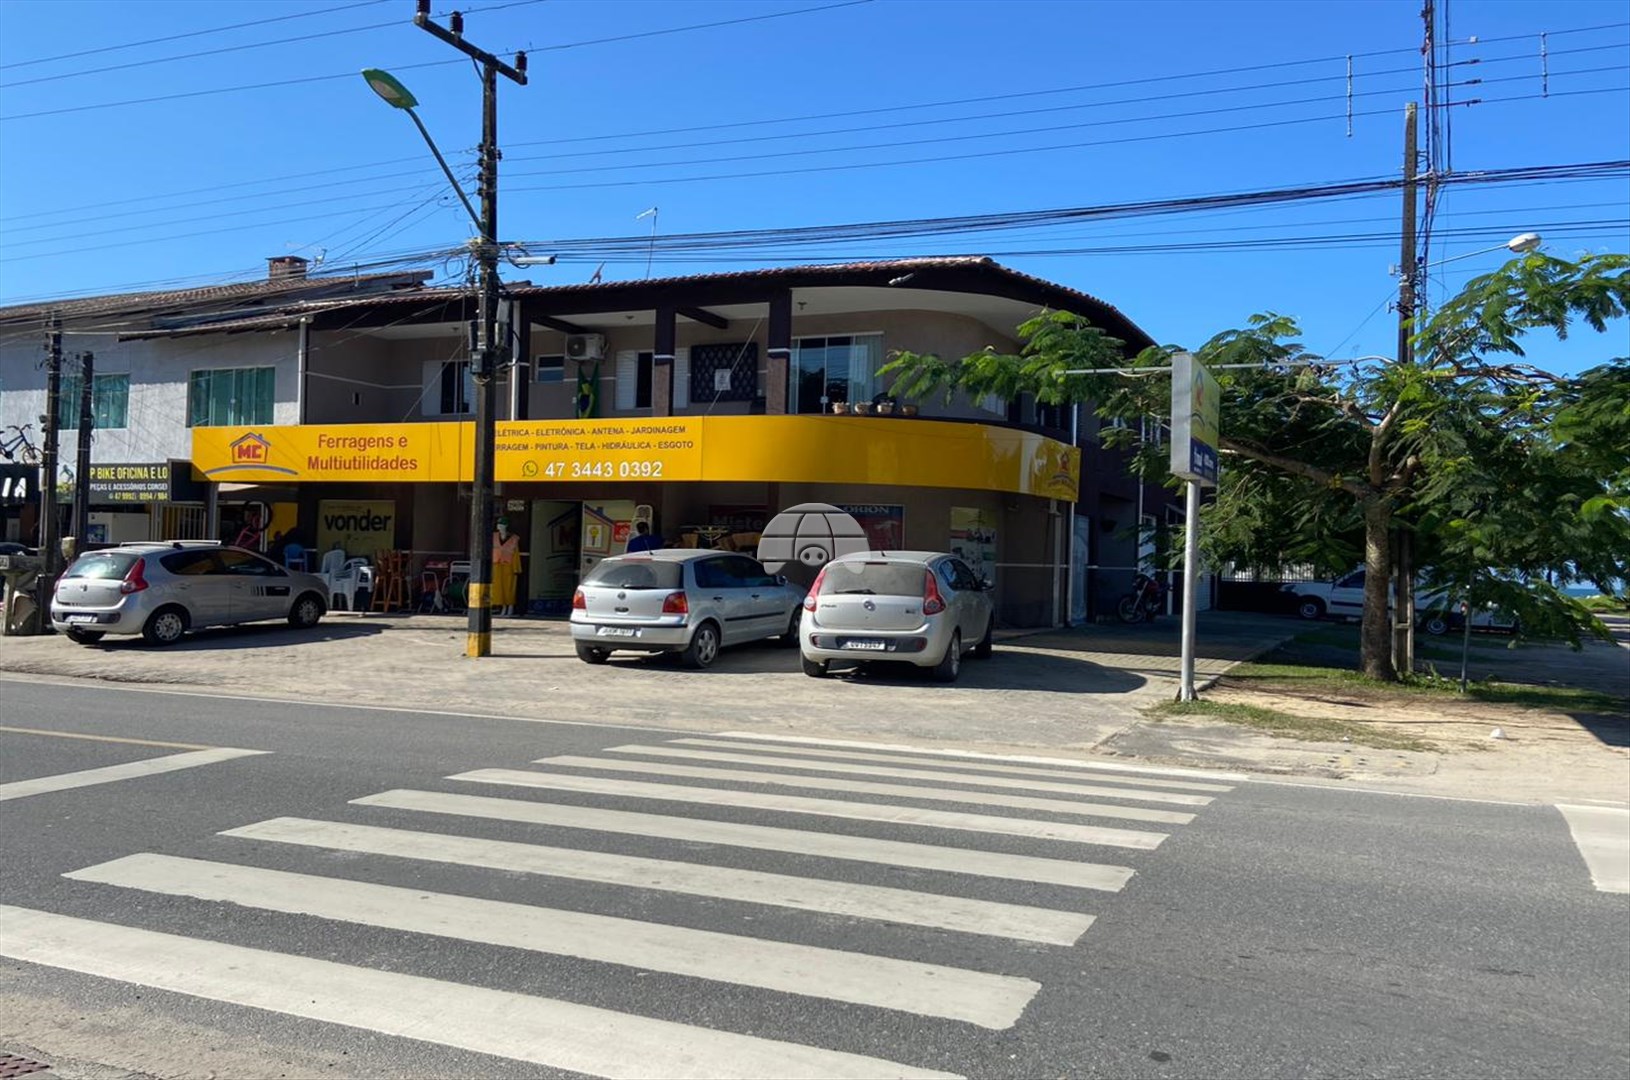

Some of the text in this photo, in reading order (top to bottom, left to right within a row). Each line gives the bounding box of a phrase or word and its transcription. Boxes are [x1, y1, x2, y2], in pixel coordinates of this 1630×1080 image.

[496, 427, 529, 437] LÉTRICA
[536, 427, 585, 436] ELETRÔNICA
[592, 427, 624, 435] ANTENA
[631, 426, 686, 435] JARDINAGEM
[318, 434, 408, 452] Ferragens e
[575, 442, 596, 450] TELA
[602, 441, 651, 450] HIDRÁULICA
[658, 441, 694, 449] ESGOTO
[238, 444, 262, 459] MC
[308, 456, 418, 471] Multiutilidades
[545, 461, 663, 478] 47 3443 0392
[97, 467, 115, 479] BIKE
[117, 467, 149, 479] OFICINA
[151, 467, 156, 479] E
[324, 508, 392, 531] vonder
